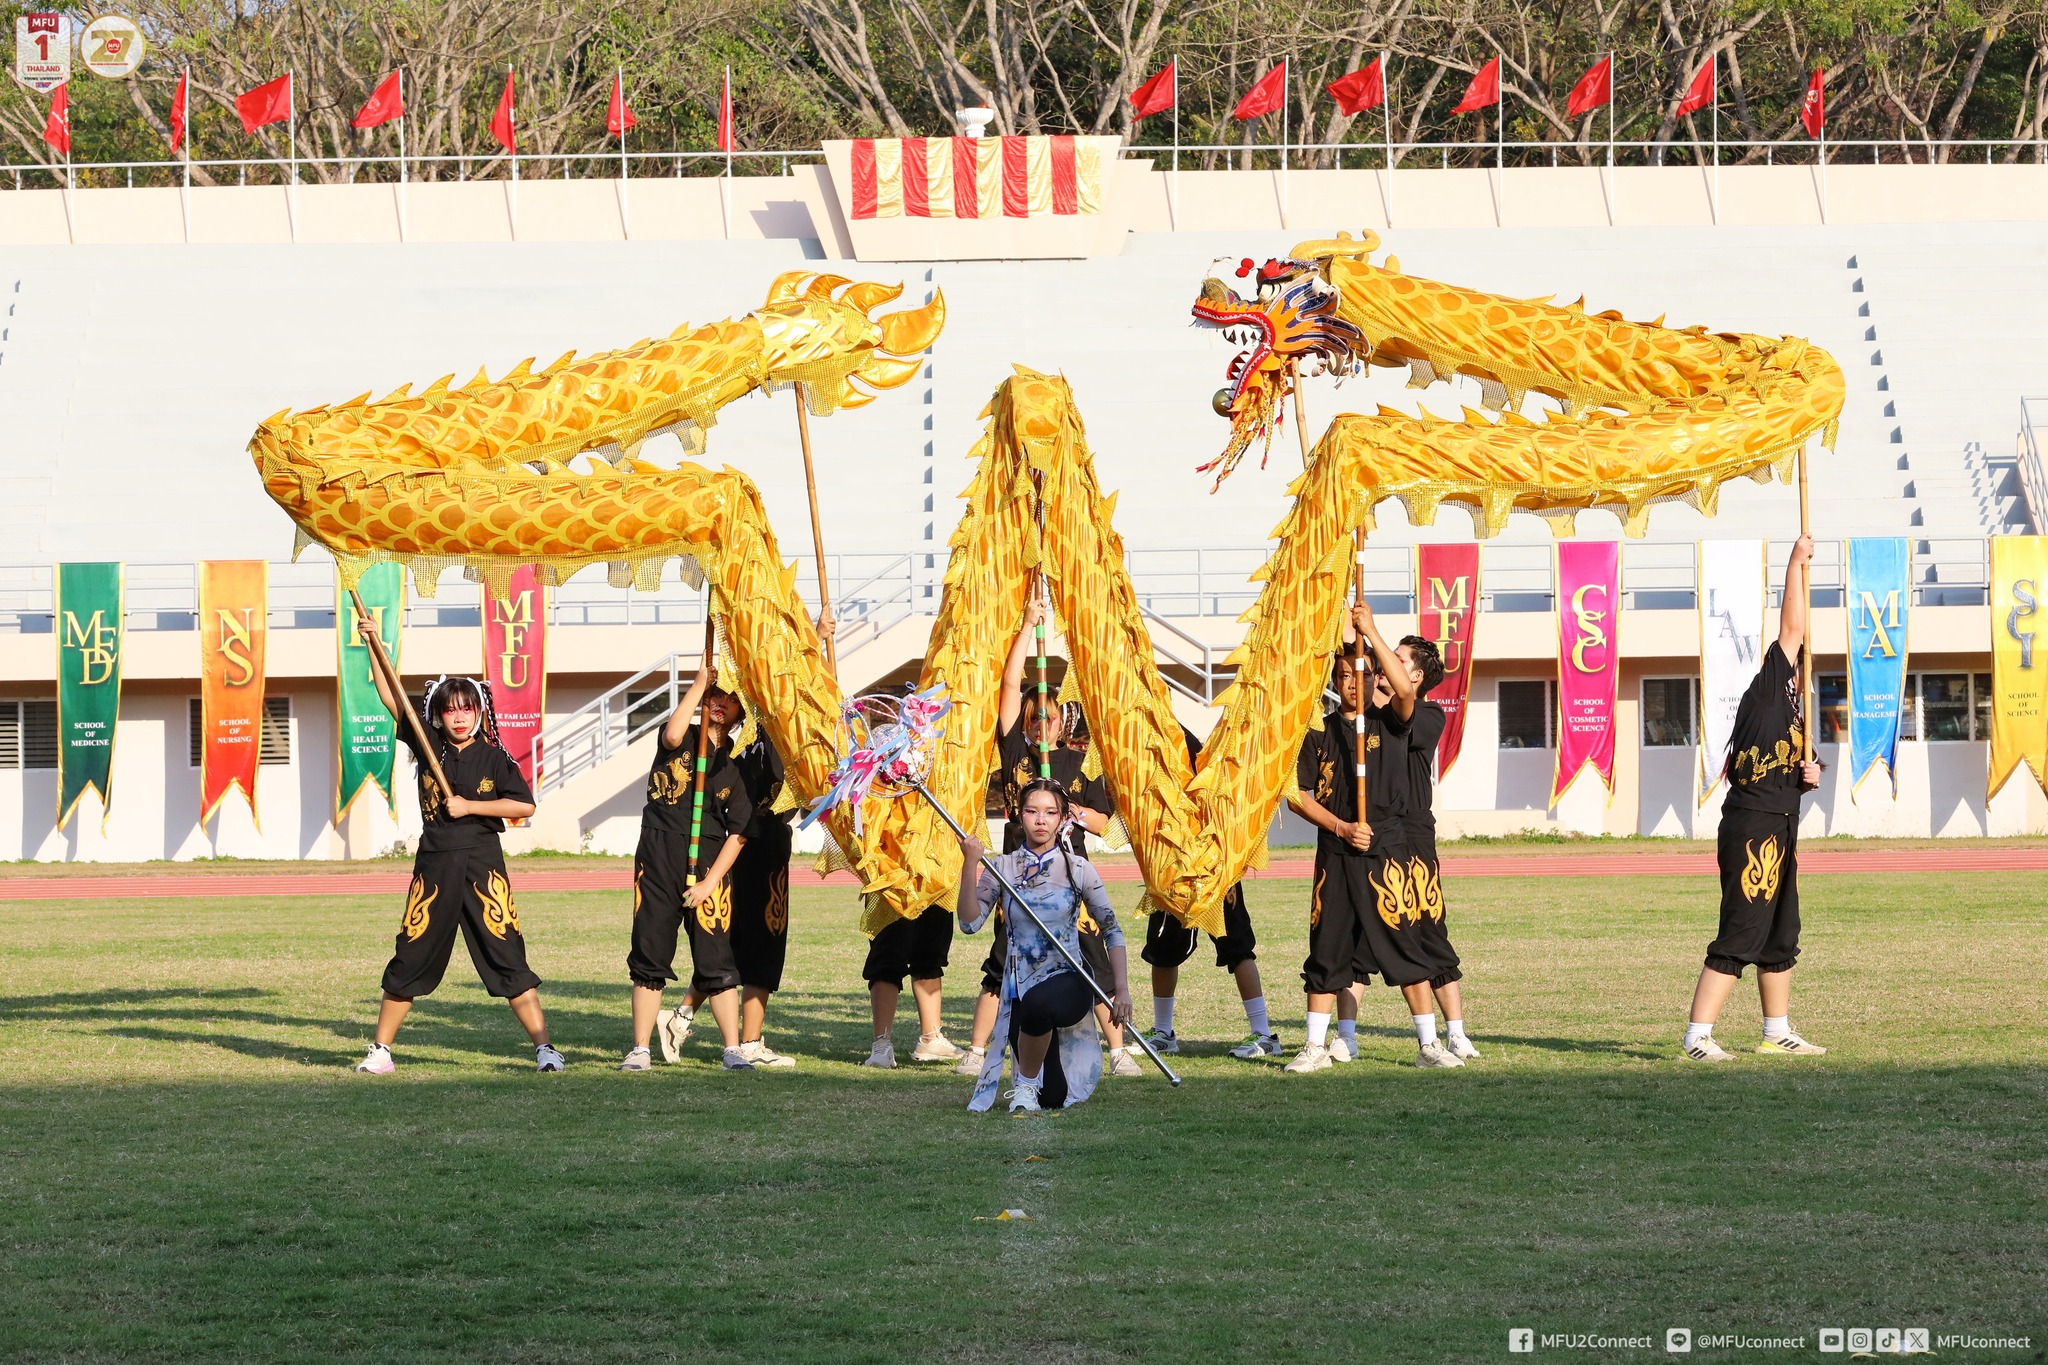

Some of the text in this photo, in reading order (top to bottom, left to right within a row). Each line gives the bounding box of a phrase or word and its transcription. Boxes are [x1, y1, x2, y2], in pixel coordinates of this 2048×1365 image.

[1708, 588, 1760, 664] LAW
[1857, 589, 1902, 659] MA
[2006, 579, 2037, 668] SCI
[1571, 584, 1607, 673] CSC
[492, 590, 535, 688] MFU
[215, 608, 254, 686] NS
[1863, 693, 1896, 701] SCHOOL
[2008, 692, 2039, 700] SCHOOL
[1573, 698, 1605, 706] SCHOOL
[1874, 702, 1885, 710] OF
[1584, 707, 1595, 715] OF
[1852, 711, 1897, 719] MANAGEME
[2006, 709, 2040, 717] SCIENCE
[218, 718, 251, 727] SCHOOL
[351, 715, 388, 723] SCHOOL
[1569, 716, 1608, 724] COSMETIC
[74, 721, 106, 729] SCHOOL
[364, 725, 376, 733] OF
[1572, 724, 1605, 732] SCIENCE
[85, 730, 96, 738] OF
[71, 739, 110, 747] MEDICINE
[217, 736, 252, 744] NURSING
[352, 735, 388, 744] HEALTH
[351, 745, 389, 754] SCIENCE
